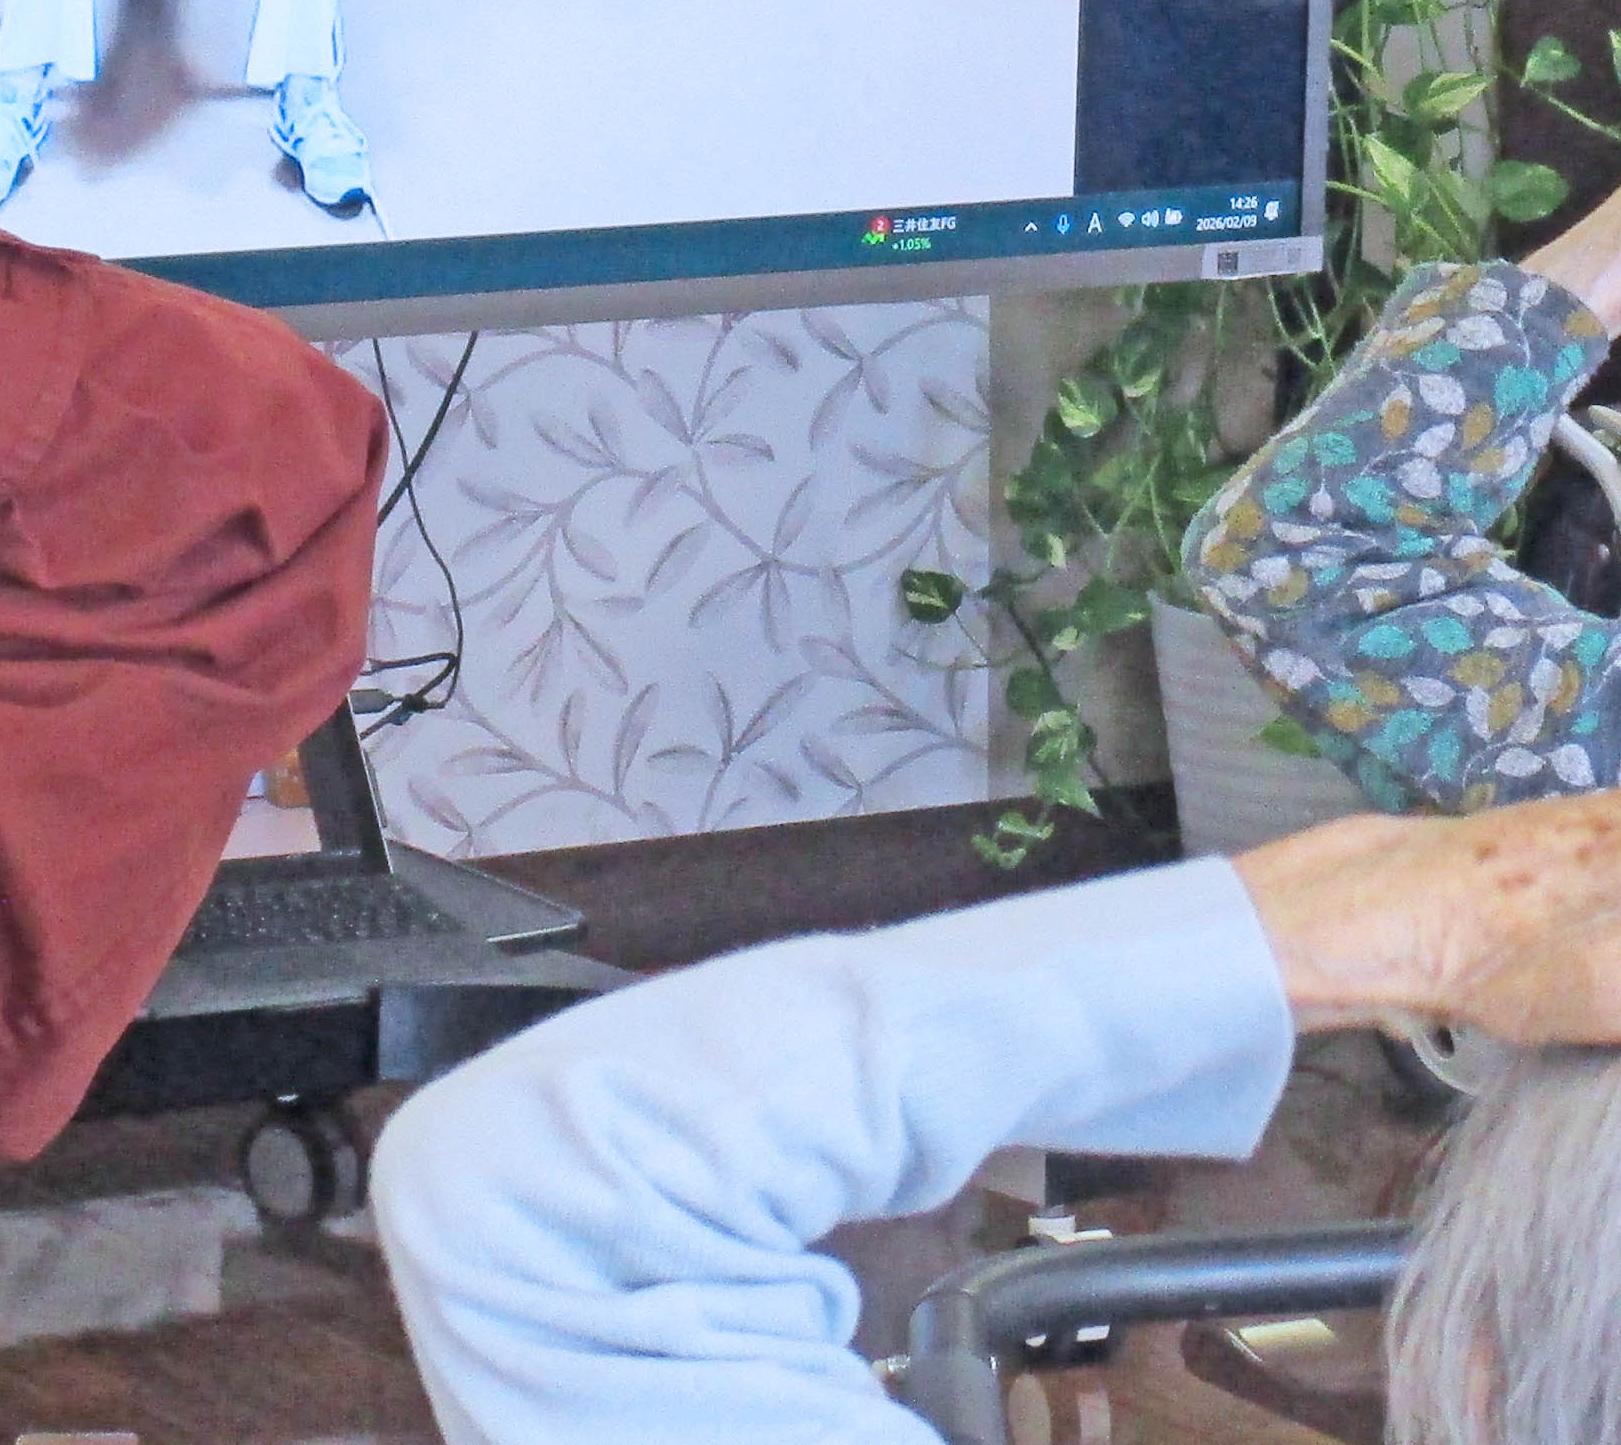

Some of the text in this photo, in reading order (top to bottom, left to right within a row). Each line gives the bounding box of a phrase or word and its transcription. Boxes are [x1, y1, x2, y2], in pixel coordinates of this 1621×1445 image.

[892, 216, 957, 234] 三井住友FG
[1195, 214, 1258, 232] 2026/02/09
